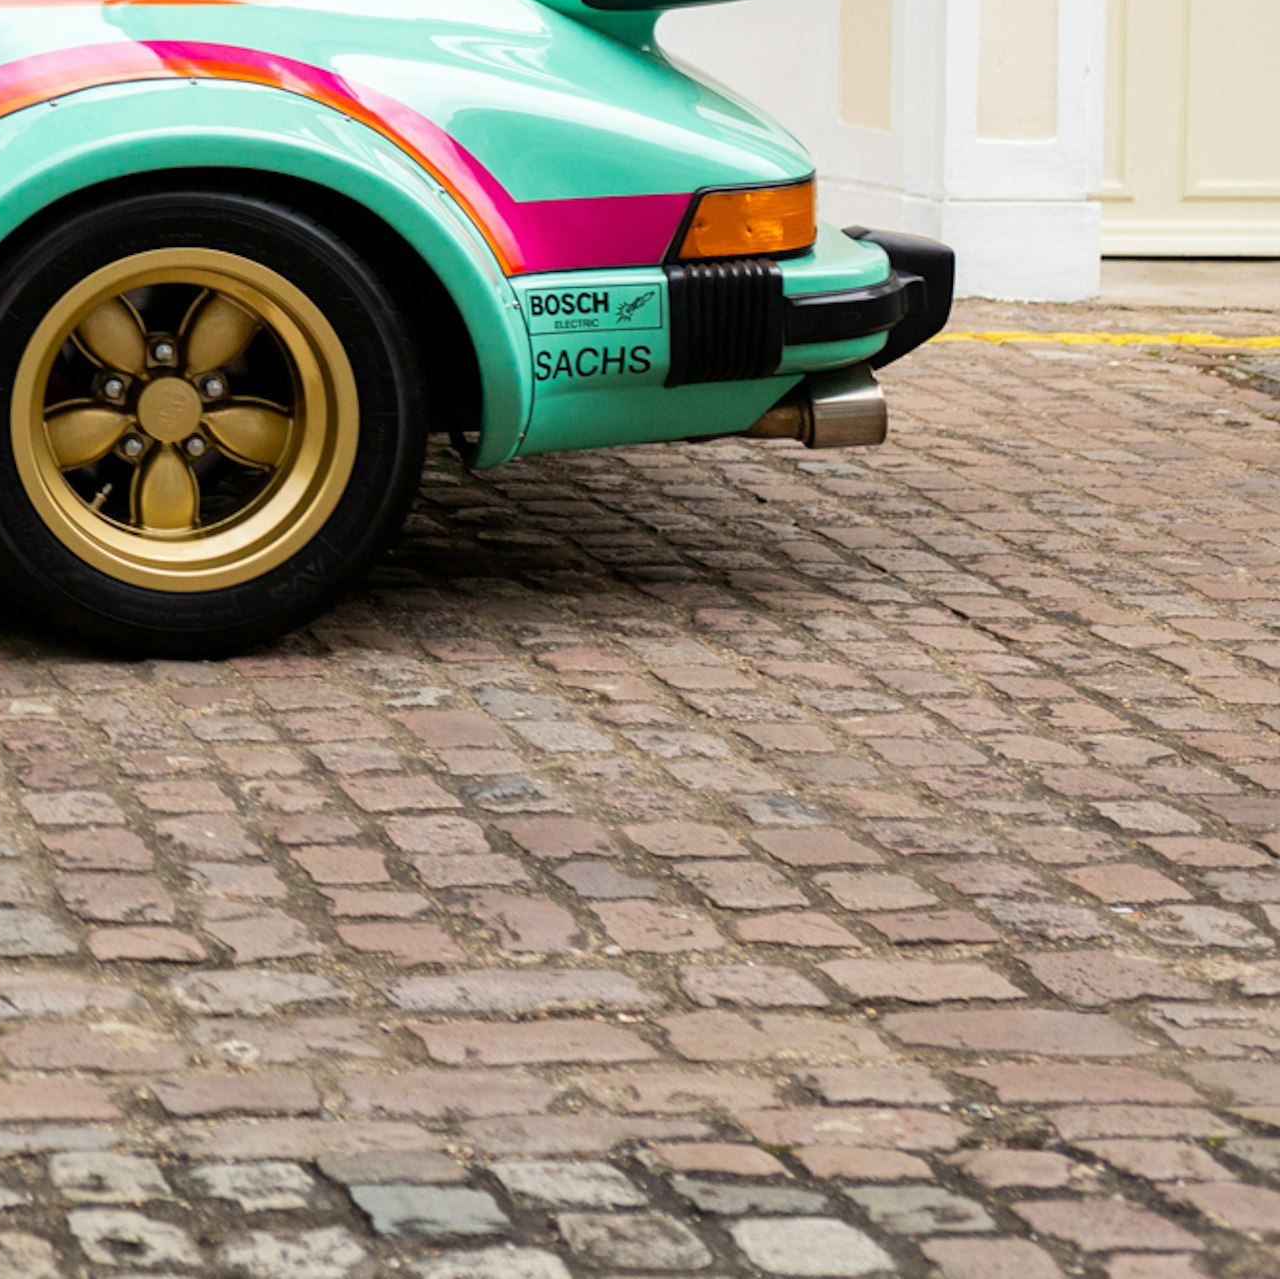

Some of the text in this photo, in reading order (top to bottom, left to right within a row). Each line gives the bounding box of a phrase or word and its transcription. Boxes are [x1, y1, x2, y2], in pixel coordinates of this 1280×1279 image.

[530, 292, 609, 316] BOSCH
[554, 318, 599, 329] ELECTRIC
[536, 345, 651, 381] SACHS
